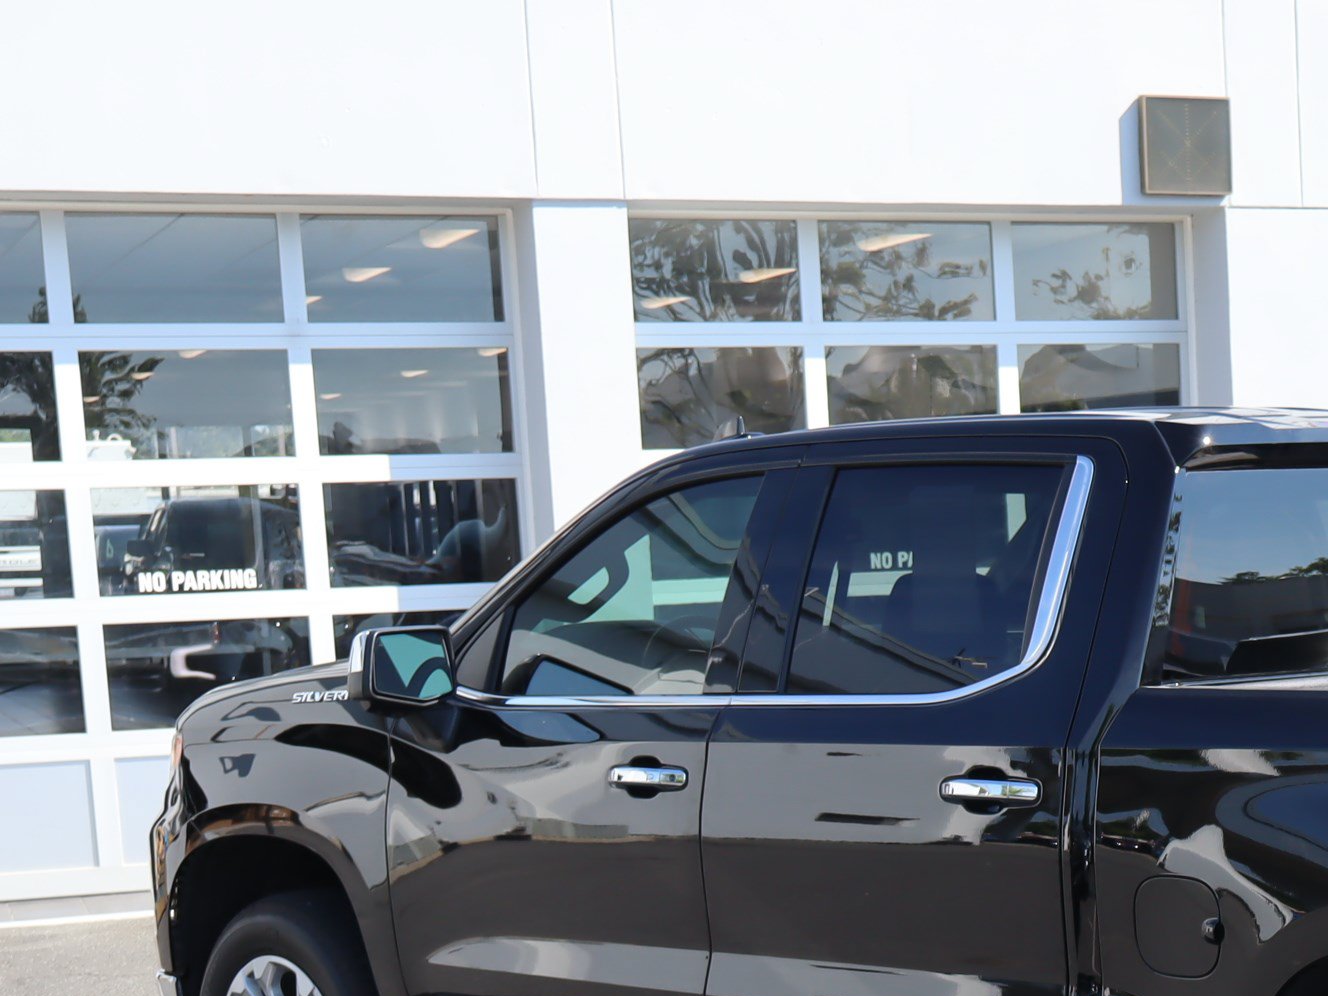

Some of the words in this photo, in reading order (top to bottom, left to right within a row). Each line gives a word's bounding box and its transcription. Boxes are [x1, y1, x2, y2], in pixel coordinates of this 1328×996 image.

[869, 551, 893, 569] NO
[138, 571, 167, 593] NO
[171, 567, 258, 592] PARKING
